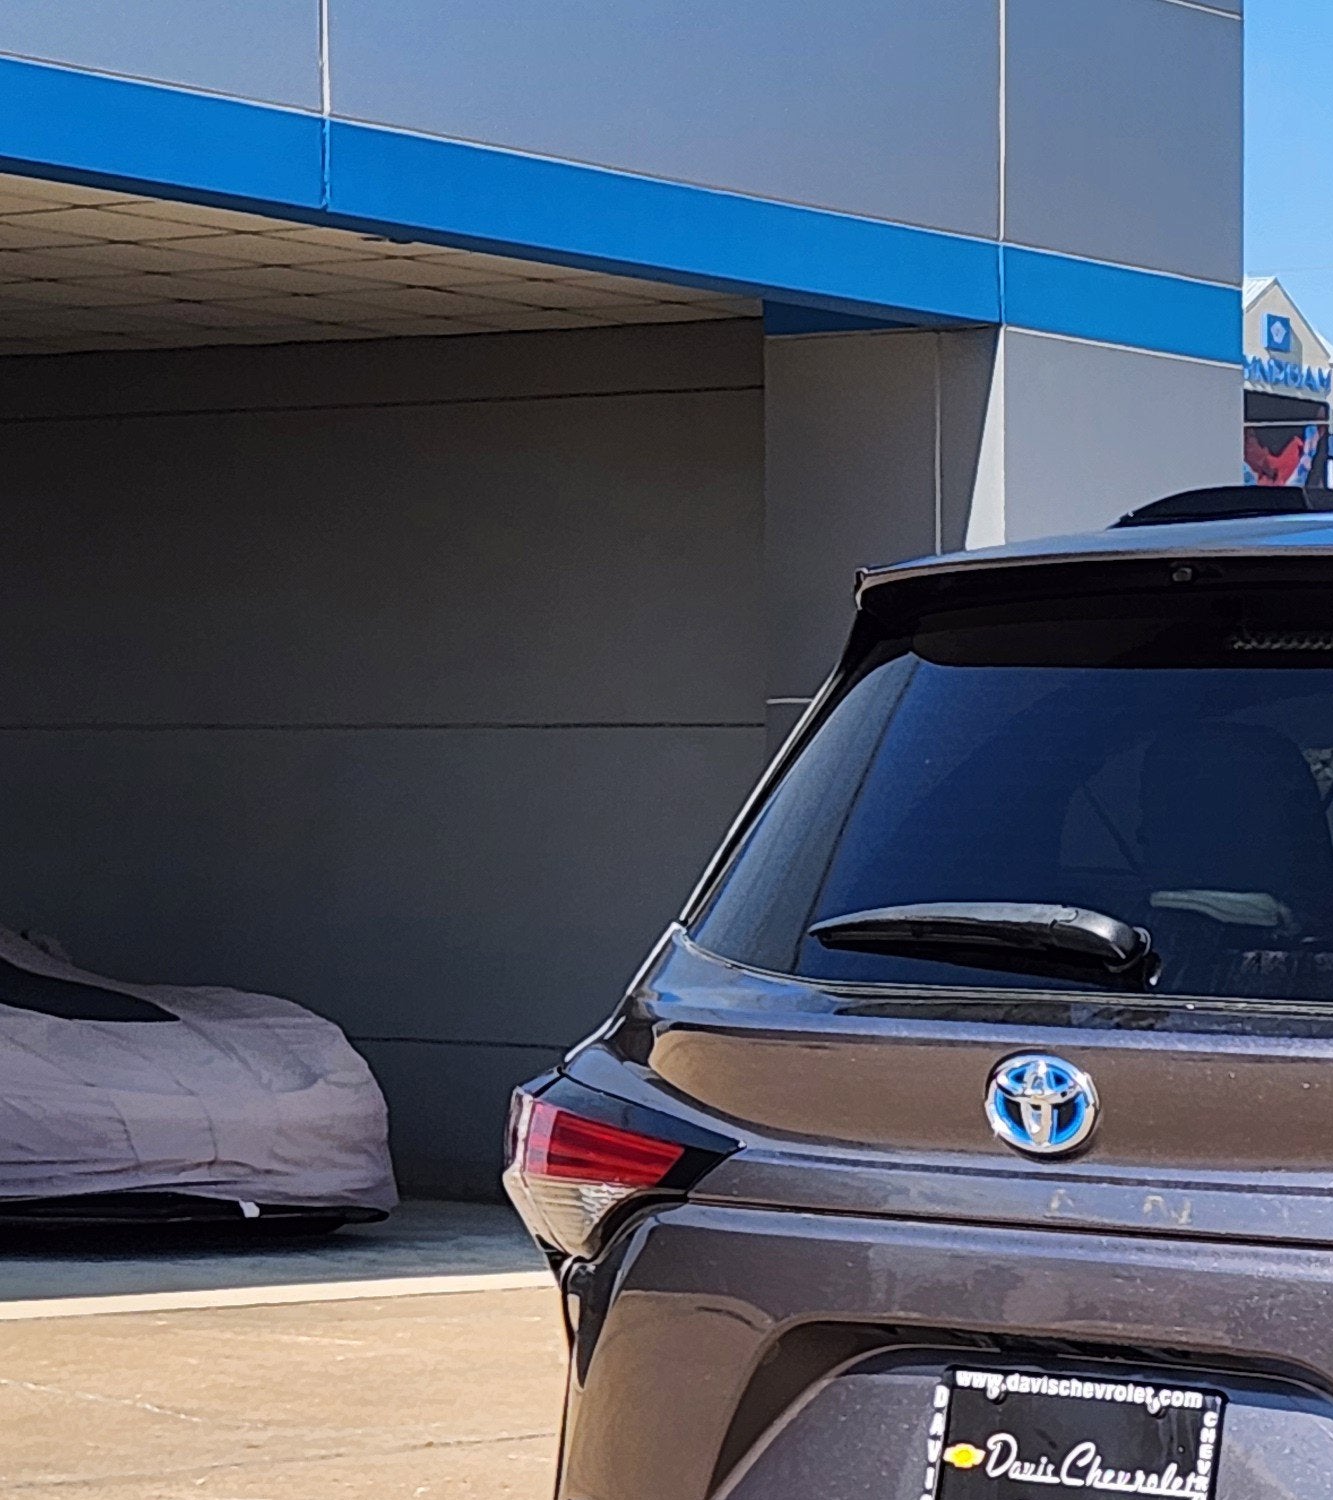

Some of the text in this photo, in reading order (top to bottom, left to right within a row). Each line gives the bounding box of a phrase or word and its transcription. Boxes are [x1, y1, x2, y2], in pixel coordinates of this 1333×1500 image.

[956, 1370, 1203, 1410] www.davischevrolet.com
[985, 1432, 1200, 1498] Davis Chevrolet
